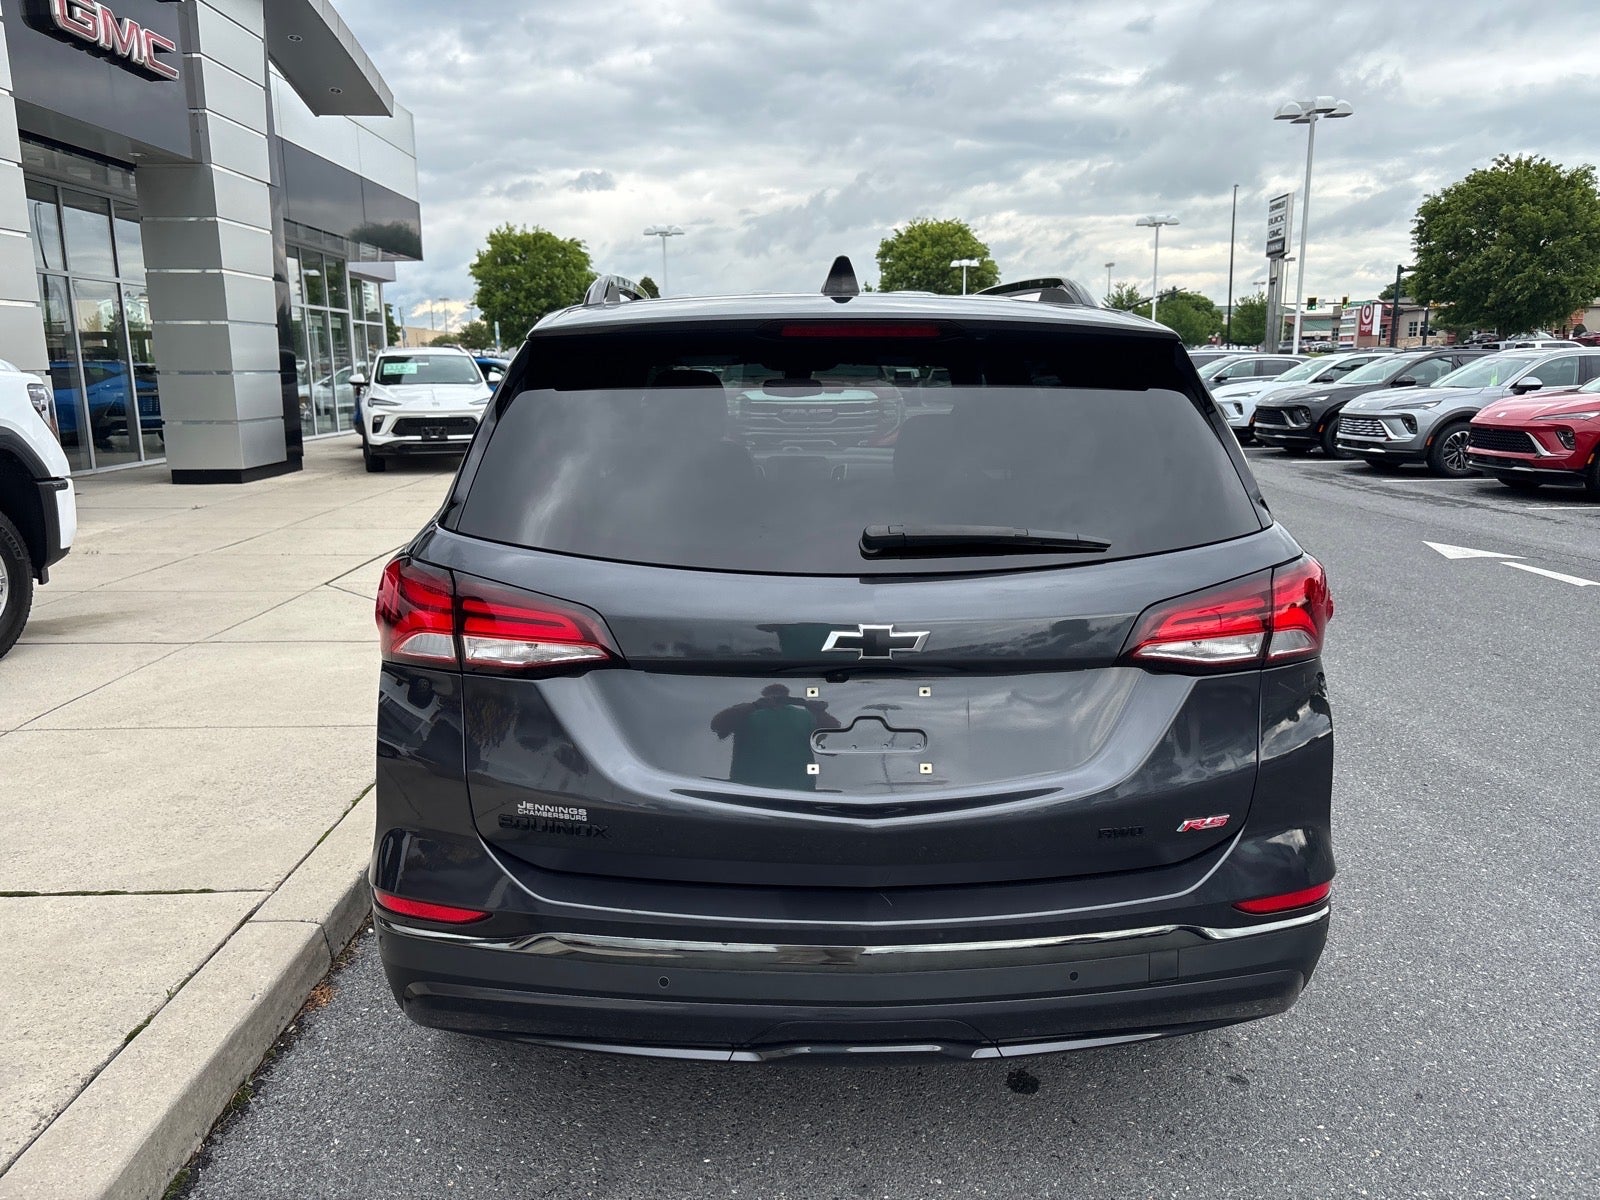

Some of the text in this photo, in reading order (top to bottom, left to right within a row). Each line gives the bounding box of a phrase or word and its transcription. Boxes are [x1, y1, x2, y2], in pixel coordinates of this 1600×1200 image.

[50, 0, 180, 81] GMC
[517, 800, 588, 816] JENNINGS
[517, 808, 588, 822] CHAMBERSBURG
[498, 813, 611, 839] EQUINOX
[1176, 813, 1231, 832] RS
